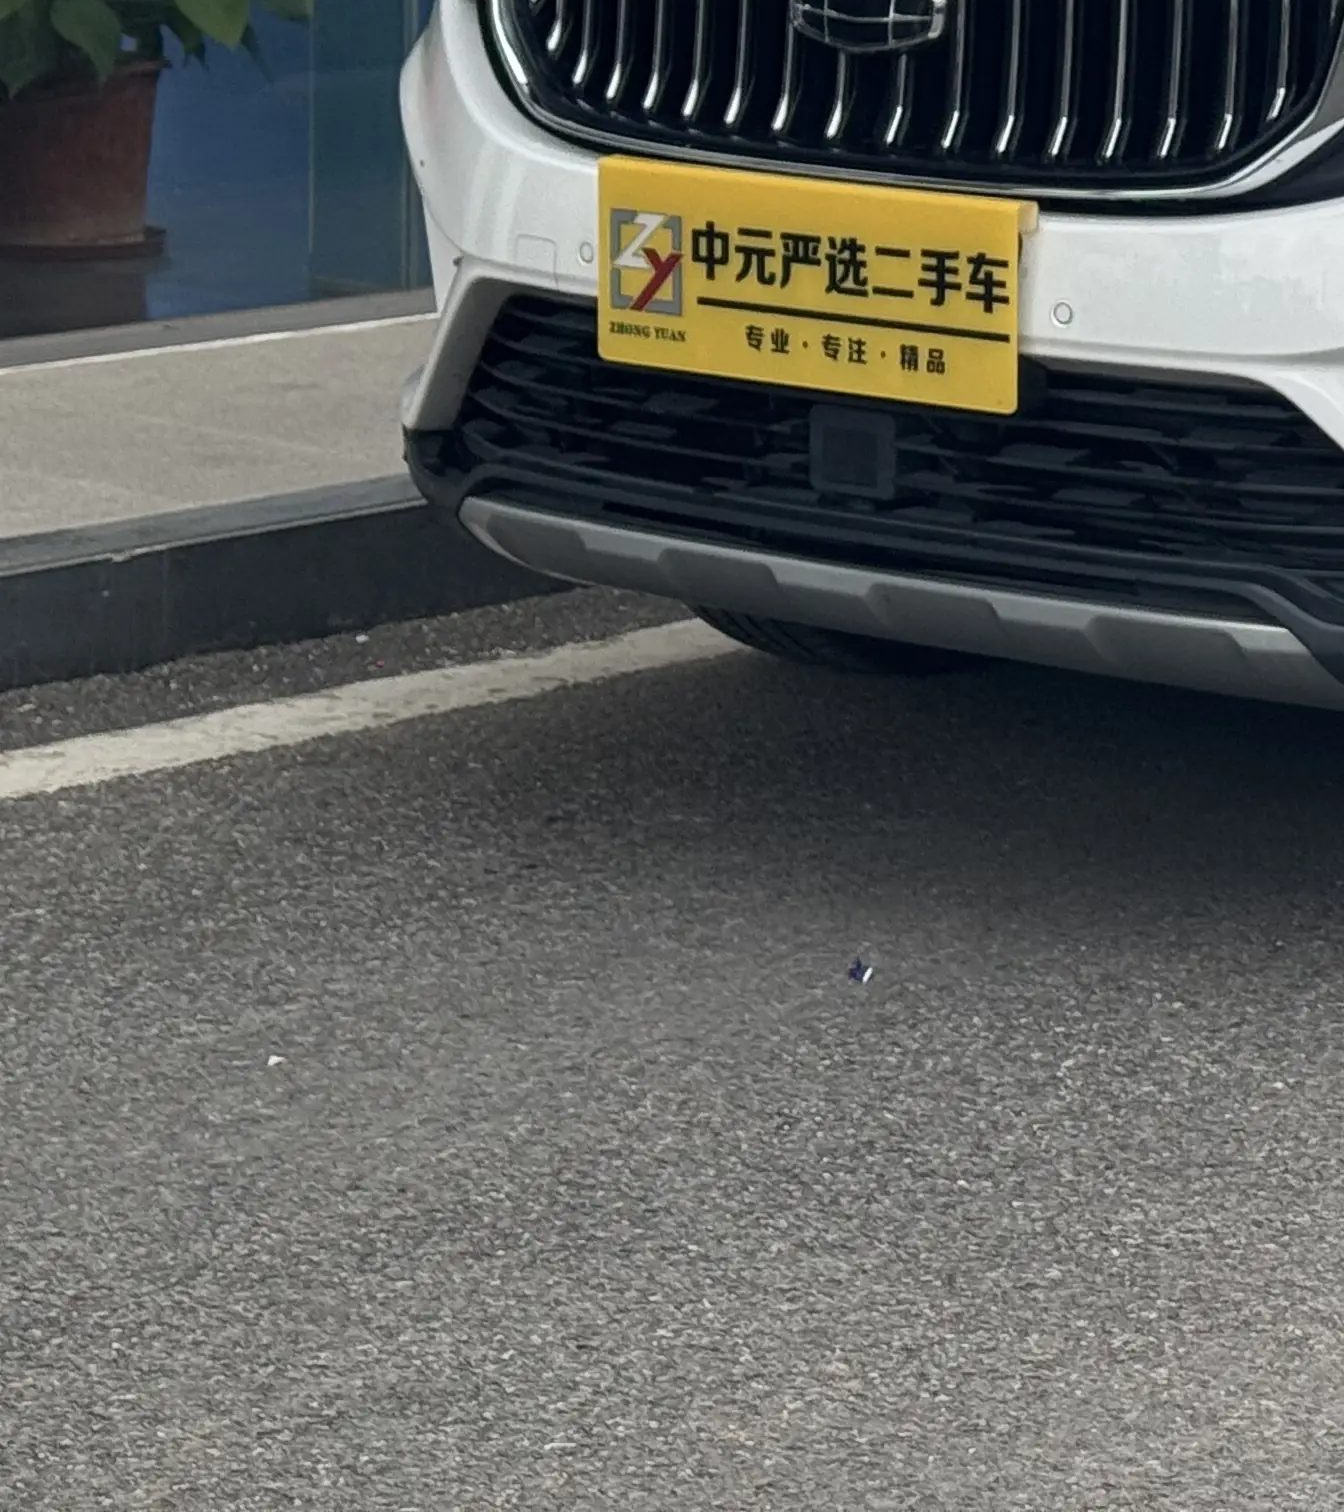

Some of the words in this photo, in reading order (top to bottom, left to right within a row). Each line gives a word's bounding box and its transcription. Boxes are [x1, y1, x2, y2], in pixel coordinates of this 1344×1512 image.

[690, 220, 1011, 315] 中元严选二手车
[609, 321, 650, 339] ZHONG
[654, 326, 687, 343] YUAN
